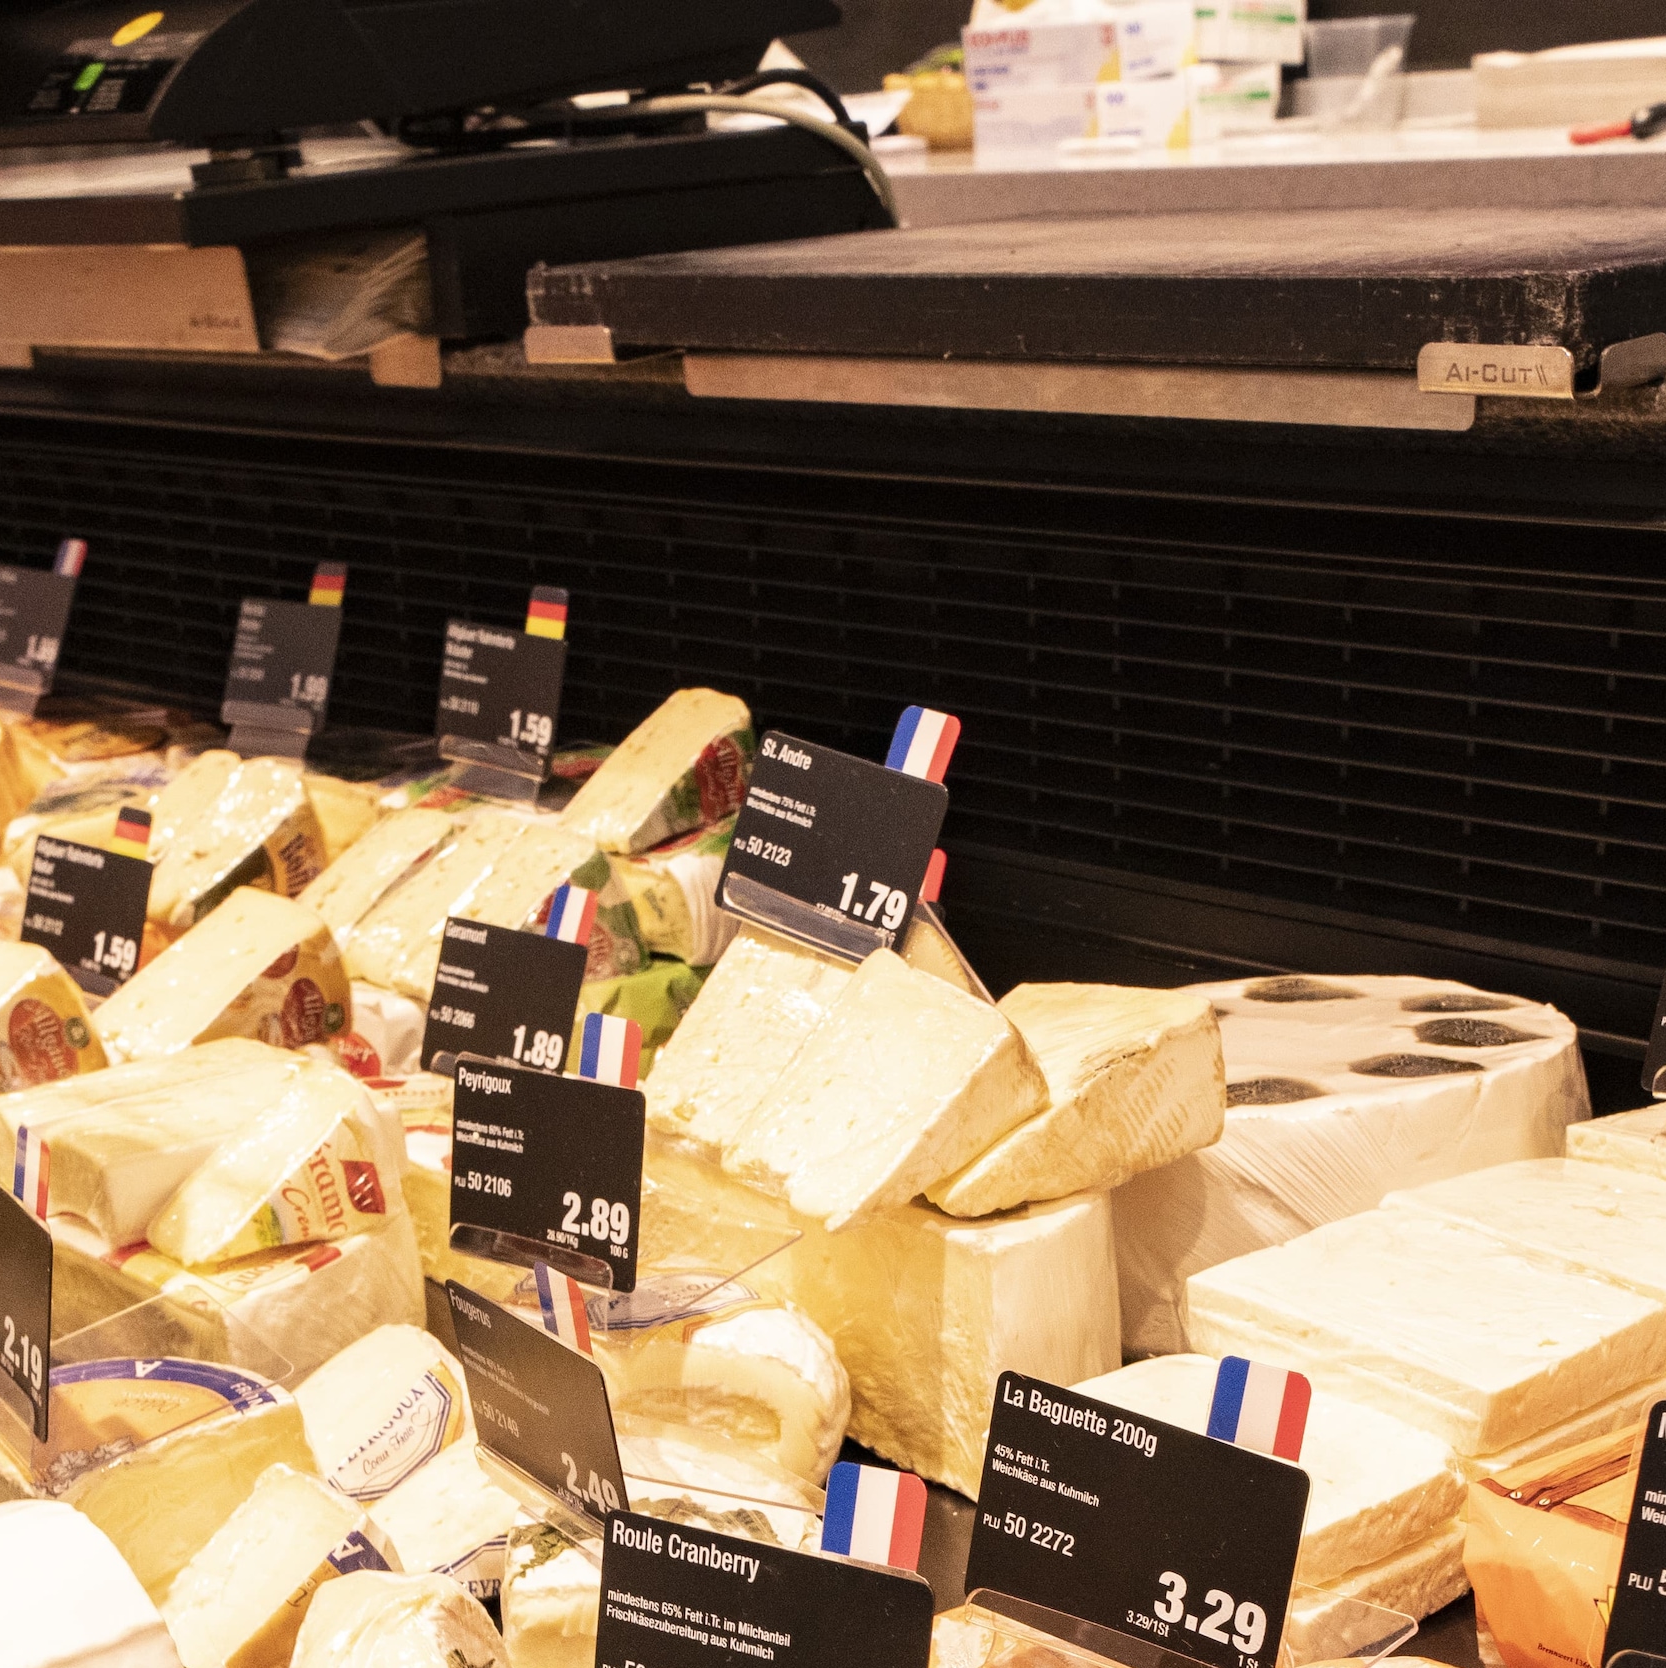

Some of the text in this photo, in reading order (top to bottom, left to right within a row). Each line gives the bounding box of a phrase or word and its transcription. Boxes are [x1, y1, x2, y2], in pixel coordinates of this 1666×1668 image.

[761, 738, 812, 770] St. Andre
[746, 836, 763, 856] 50
[762, 842, 792, 866] 2123
[839, 872, 908, 930] 1.79
[94, 930, 137, 972] 1.59
[513, 1024, 564, 1070] 1.89
[458, 1067, 511, 1094] Peyrigoux
[468, 1171, 482, 1191] 50
[484, 1175, 511, 1197] 2106
[562, 1192, 630, 1245] 2.89
[610, 1244, 628, 1259] 100 G
[450, 1289, 491, 1329] Fougerus
[4, 1314, 43, 1390] 2.19
[482, 1400, 519, 1438] 50 2149
[1003, 1381, 1158, 1457] La Baguette 200g
[994, 1444, 1014, 1460] 45%
[1016, 1452, 1034, 1468] Fett
[561, 1452, 620, 1514] 2.49
[992, 1459, 1100, 1507] Weichkäse aus Kuhmilch
[612, 1519, 760, 1583] Roule Cranberry
[983, 1512, 1075, 1557] PLU 50 2272
[1628, 1572, 1653, 1591] PLU
[606, 1604, 774, 1660] Frischkäsezubereitung aus Kuhmilch
[607, 1589, 659, 1614] mindestens
[662, 1602, 682, 1618] 65%
[685, 1608, 703, 1624] Fett
[723, 1618, 736, 1632] im
[738, 1622, 791, 1647] Milchanteil
[1126, 1610, 1170, 1637] 3.29/1St
[1153, 1570, 1267, 1655] 3.29
[1237, 1655, 1243, 1668] 1
